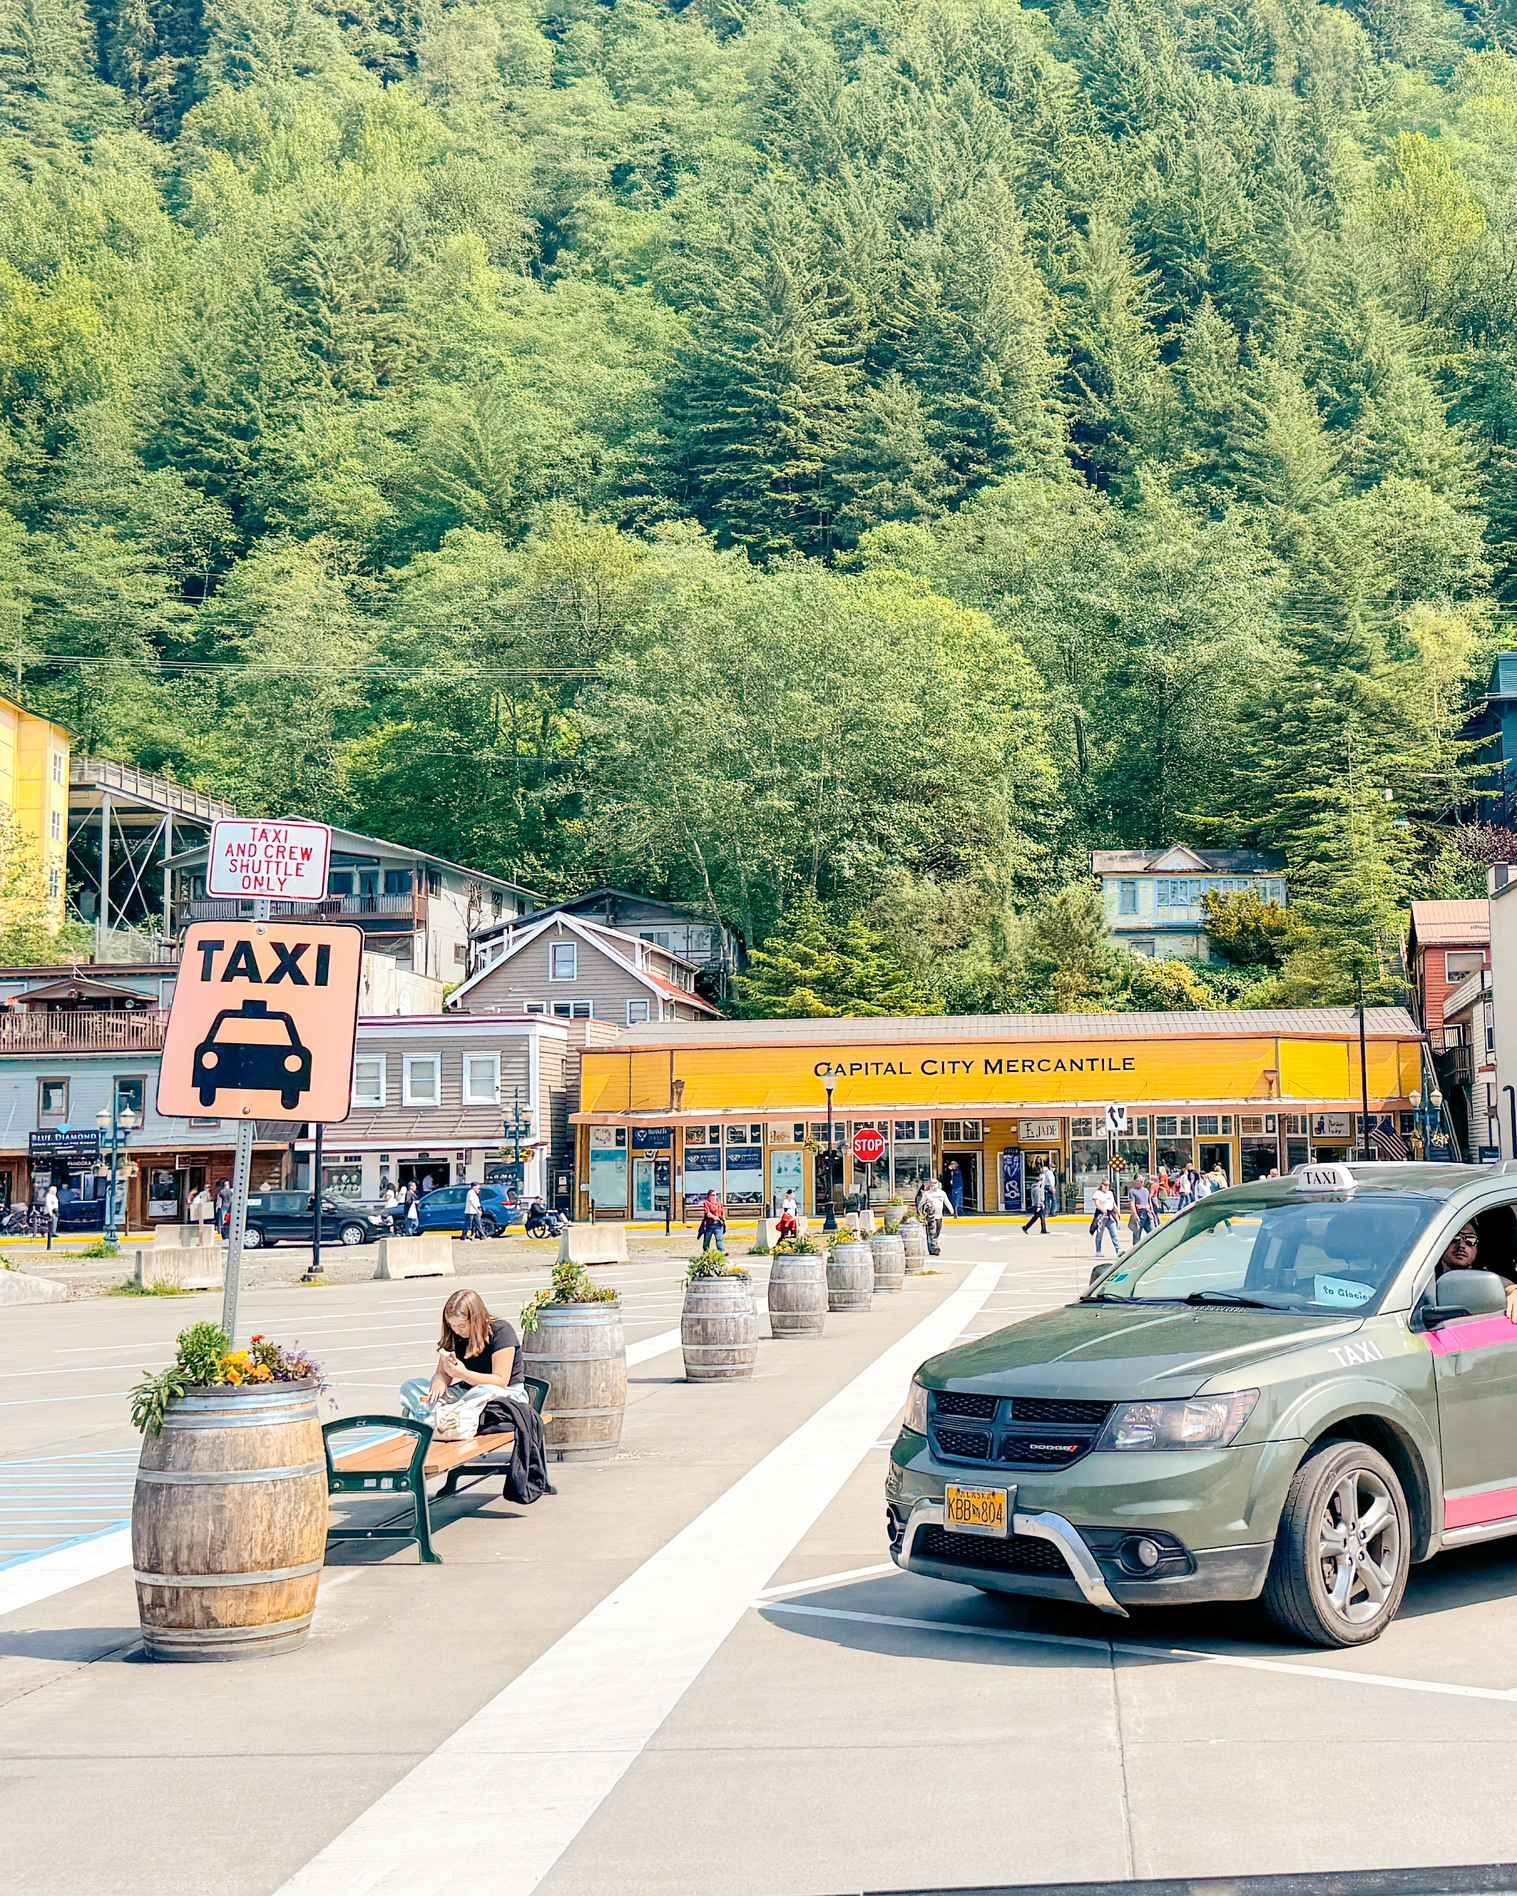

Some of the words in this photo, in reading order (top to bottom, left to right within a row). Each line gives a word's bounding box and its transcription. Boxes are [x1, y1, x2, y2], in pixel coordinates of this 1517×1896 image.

[251, 827, 288, 843] TAXI
[225, 843, 257, 858] AND
[263, 844, 313, 861] CREW
[229, 858, 305, 877] SHUTTLE
[241, 875, 287, 892] ONLY
[197, 939, 331, 986] TAXI
[813, 1061, 912, 1077] CAPITAL
[921, 1059, 975, 1076] CITY
[984, 1057, 1136, 1074] MERCANTILE
[31, 1134, 52, 1142] BLUE
[54, 1133, 97, 1141] DIAMOND
[854, 1138, 884, 1152] STOP
[1303, 1171, 1337, 1185] TAXI
[1322, 1285, 1334, 1295] to
[1337, 1288, 1369, 1300] Glacie
[1327, 1341, 1384, 1367] TAXI
[947, 1497, 971, 1522] KBB
[981, 1500, 1003, 1525] 804
